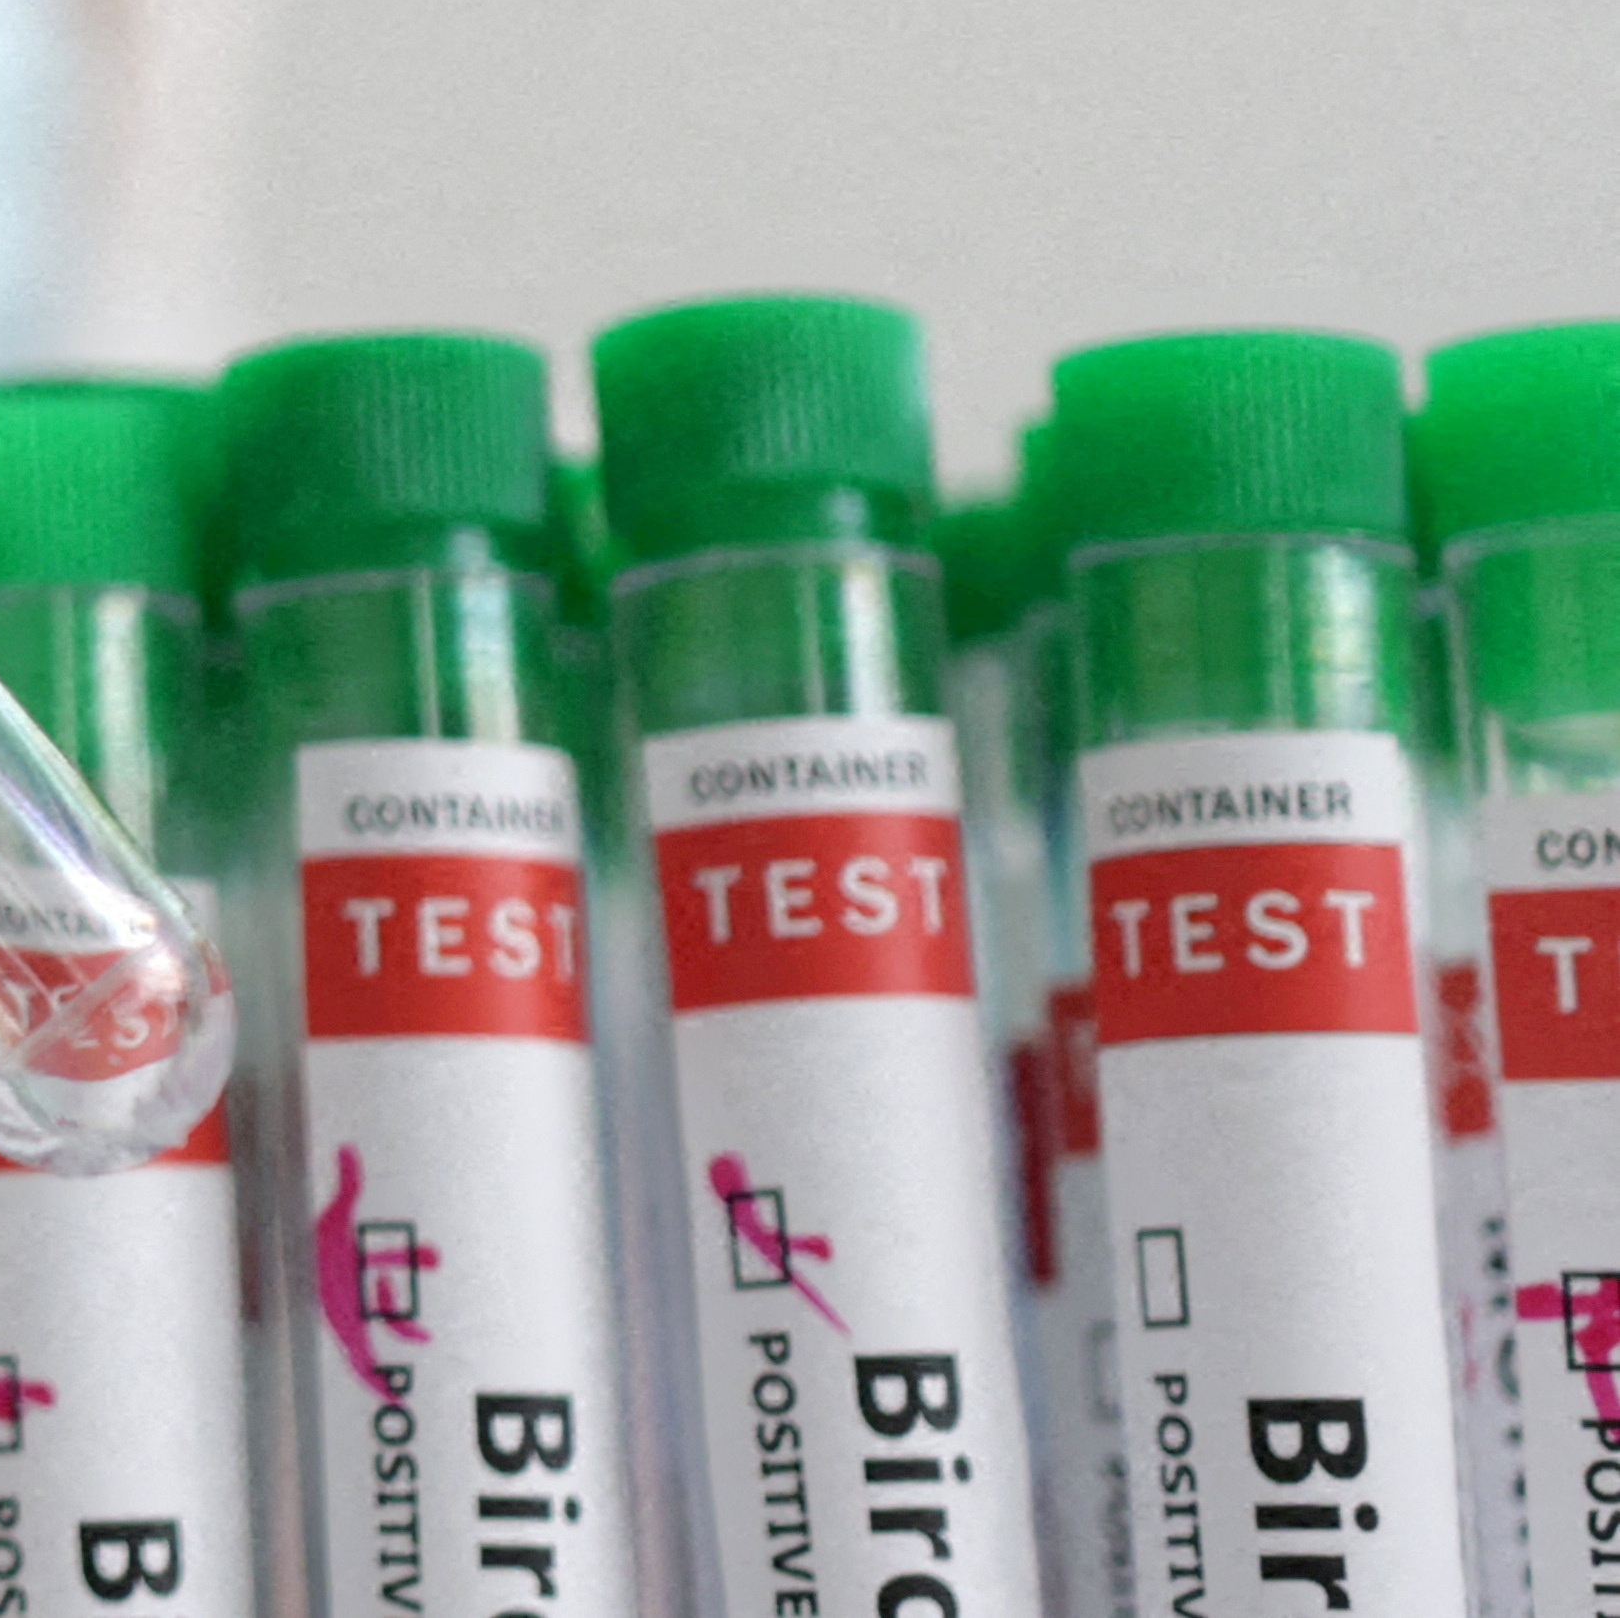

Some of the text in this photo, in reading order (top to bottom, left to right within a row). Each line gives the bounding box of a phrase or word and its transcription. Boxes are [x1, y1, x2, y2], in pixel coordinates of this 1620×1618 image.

[689, 751, 928, 802] CONTAINER
[1108, 782, 1355, 837] CONTAINER
[341, 895, 576, 981] TEST
[692, 856, 946, 944] TEST
[1110, 890, 1375, 978] TEST
[1535, 936, 1620, 1013] T
[1248, 1398, 1379, 1611] Bir
[79, 1518, 182, 1603] B
